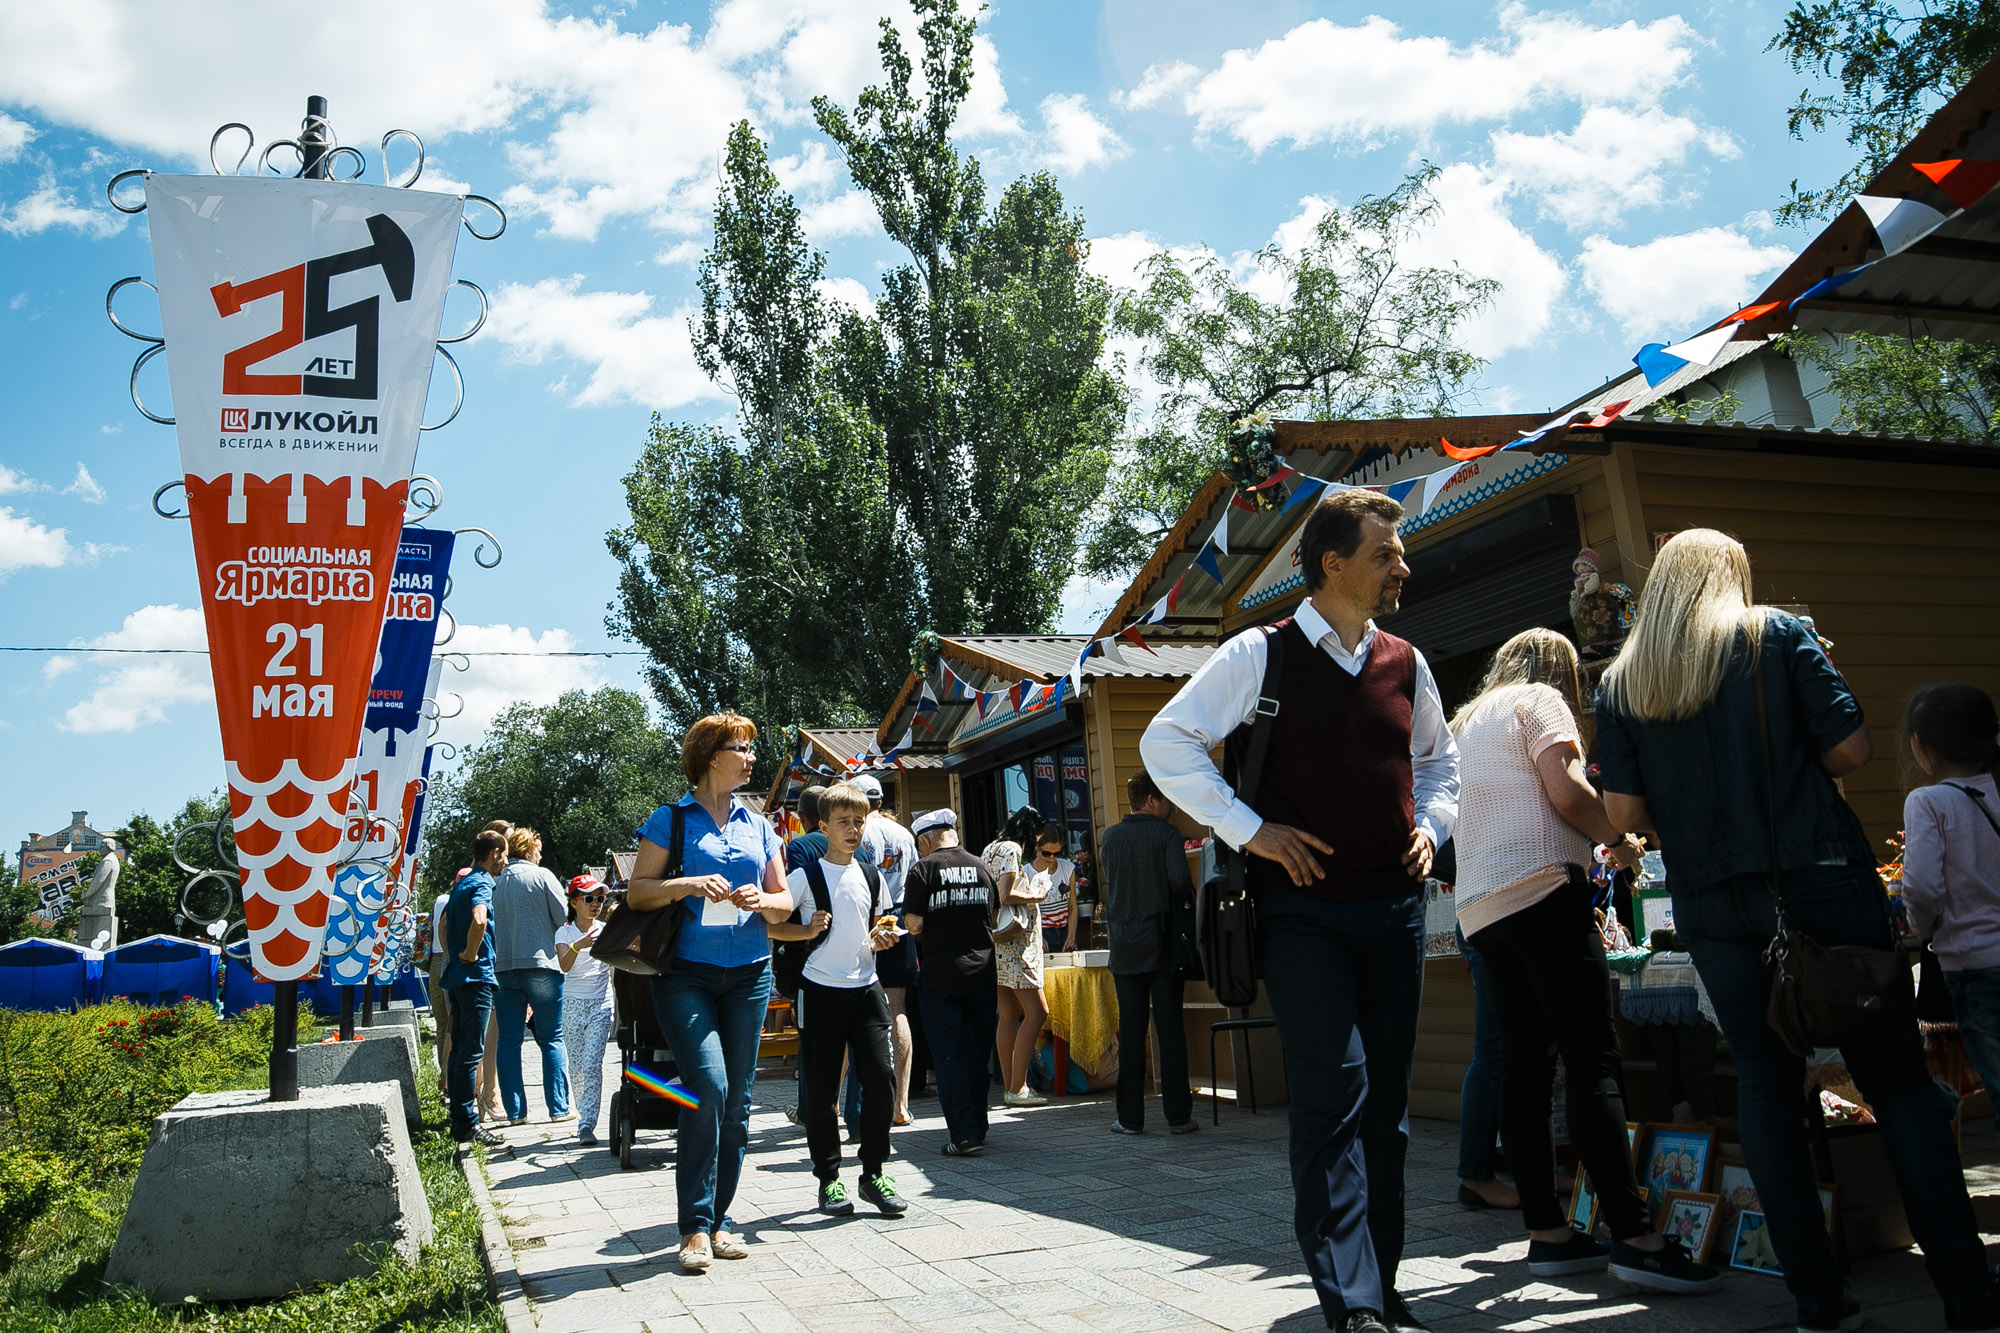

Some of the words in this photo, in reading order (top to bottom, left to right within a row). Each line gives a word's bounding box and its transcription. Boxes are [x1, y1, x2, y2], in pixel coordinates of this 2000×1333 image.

[210, 213, 415, 400] 25
[304, 357, 353, 375] ЛЕТ
[251, 410, 378, 435] ЛУКОЙЛ
[219, 438, 274, 450] ВСЕГДА
[279, 438, 287, 449] В
[292, 438, 379, 453] ДВИЖЕНИИ
[1439, 463, 1480, 492] рмарка
[248, 546, 371, 566] СОЦИАЛЬНАЯ
[216, 562, 373, 605] Ярмарка
[265, 623, 324, 677] 21
[252, 684, 334, 718] мая
[940, 866, 978, 885] РОЖДЕН
